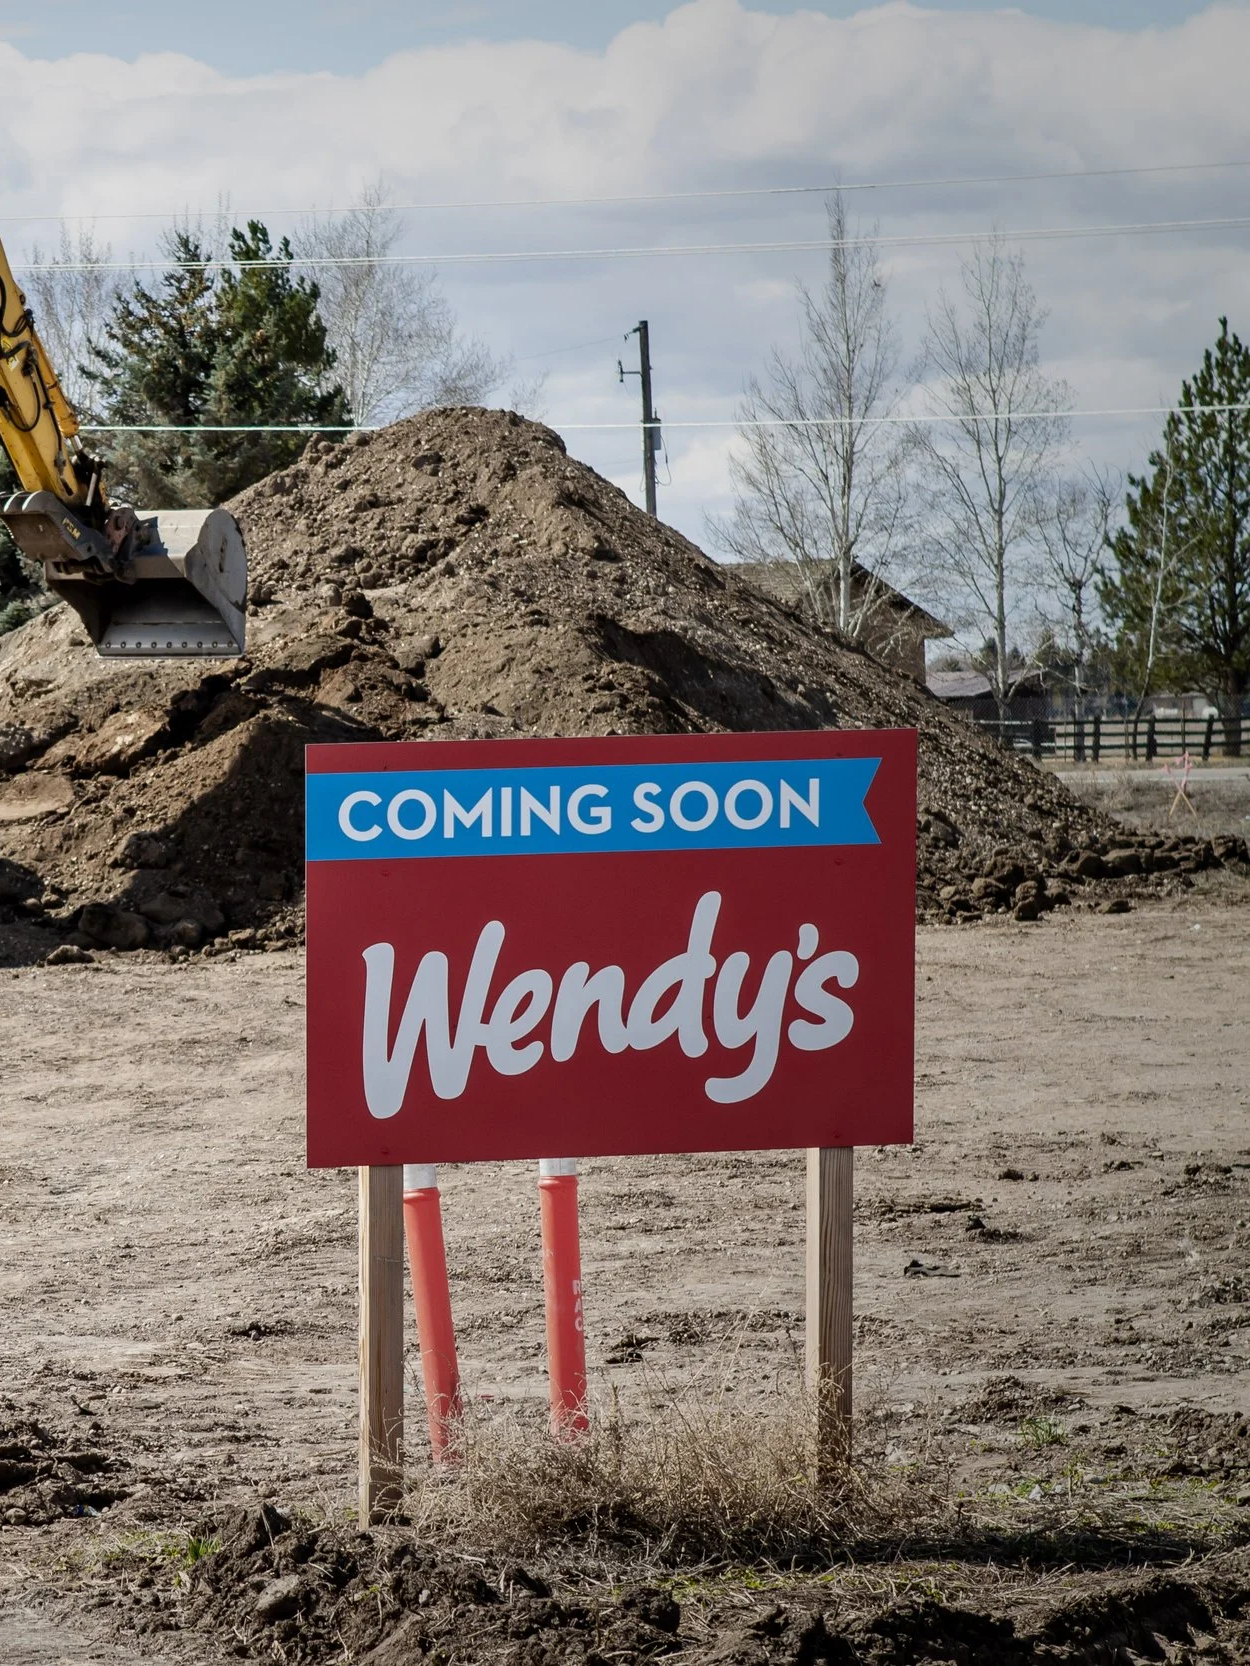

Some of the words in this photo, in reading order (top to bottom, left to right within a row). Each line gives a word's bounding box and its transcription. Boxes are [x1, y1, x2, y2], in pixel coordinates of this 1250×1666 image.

[338, 784, 612, 842] COMING
[631, 778, 820, 833] SOON
[362, 891, 860, 1119] Wendy's
